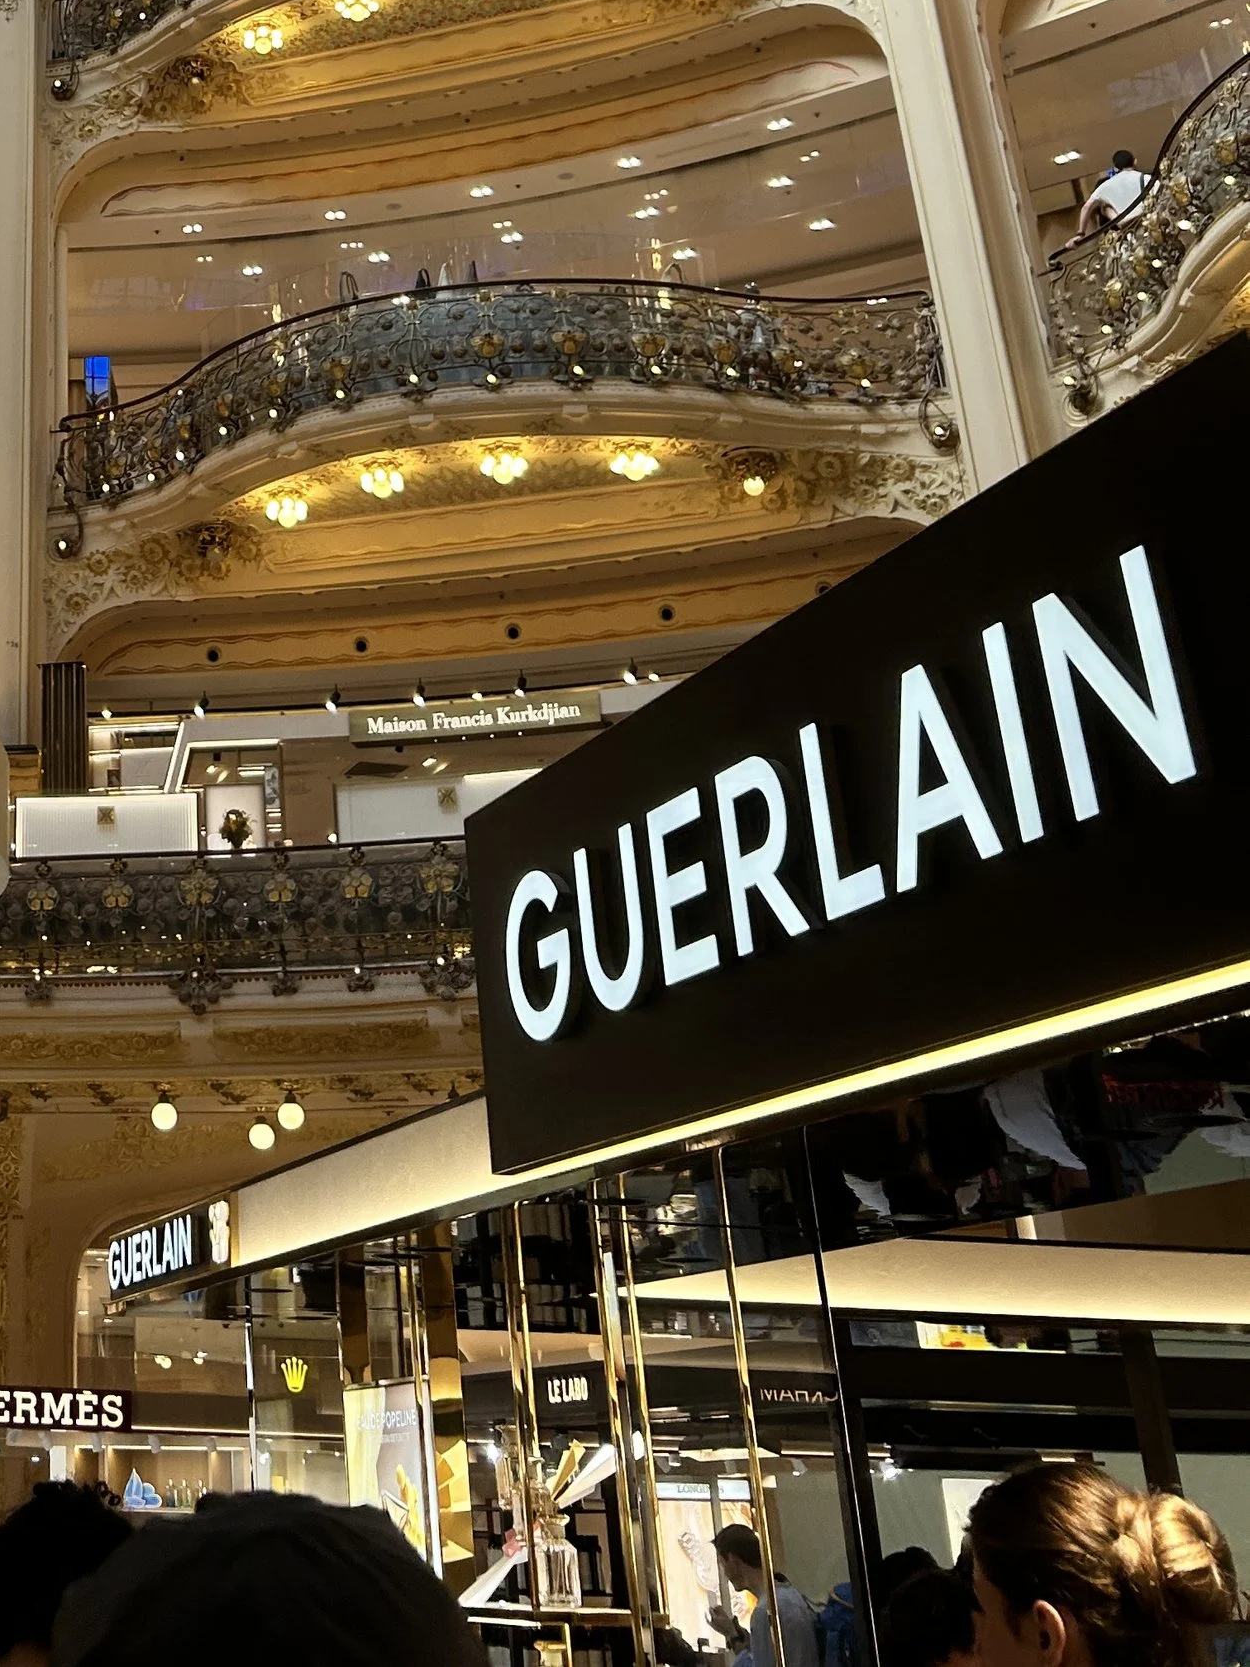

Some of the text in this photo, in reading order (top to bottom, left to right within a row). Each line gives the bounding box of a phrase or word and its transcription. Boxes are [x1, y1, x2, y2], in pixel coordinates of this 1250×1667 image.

[366, 702, 582, 734] Maison Francis Kurkdjian
[506, 544, 1198, 1042] GUERLAIN
[108, 1213, 193, 1291] GUERLAIN
[547, 1376, 589, 1404] LE LABO
